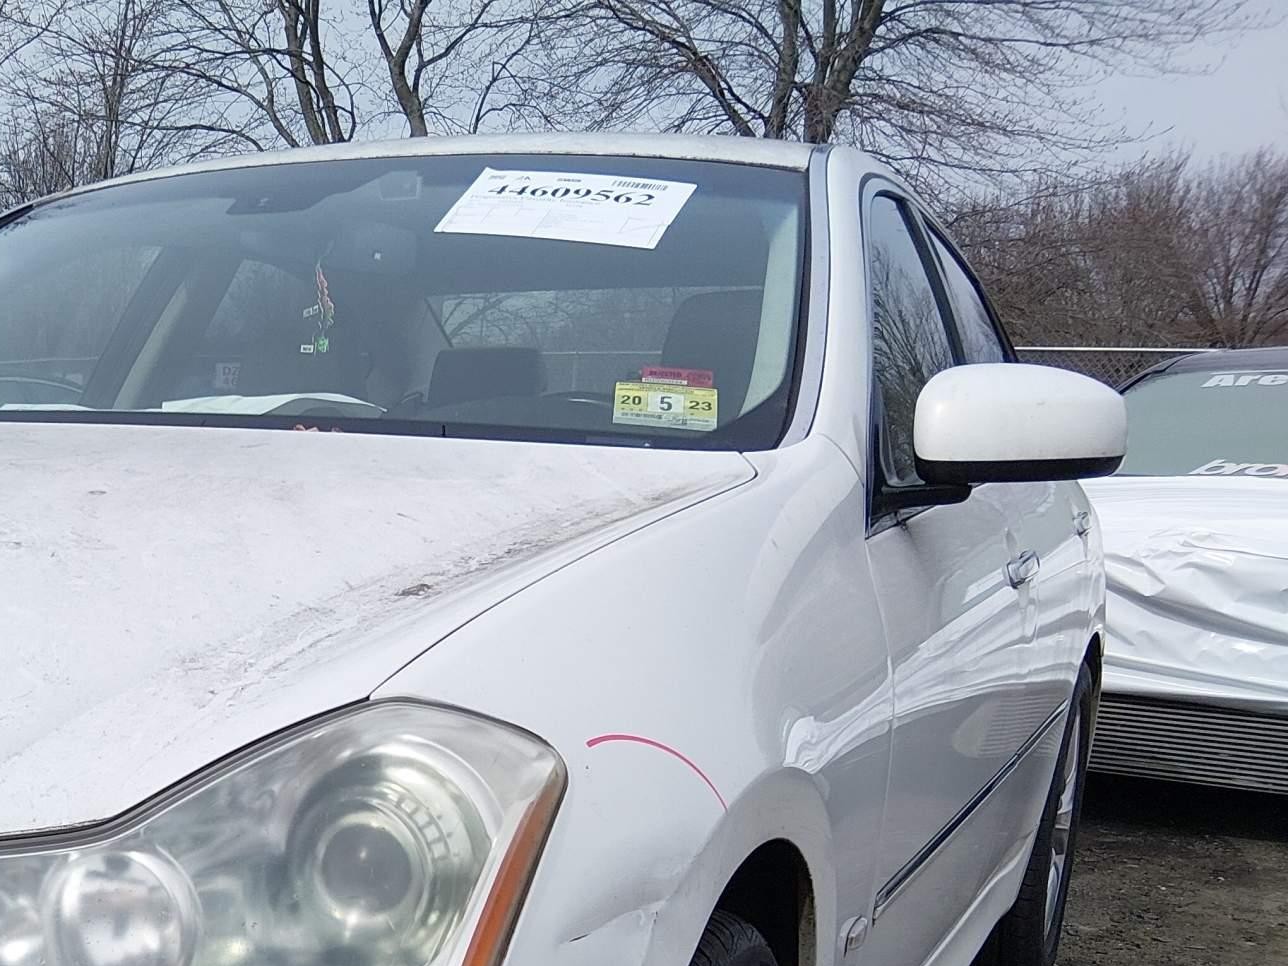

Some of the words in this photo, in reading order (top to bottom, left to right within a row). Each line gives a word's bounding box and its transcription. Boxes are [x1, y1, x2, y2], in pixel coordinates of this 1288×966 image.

[487, 184, 655, 206] 44609562
[620, 394, 642, 406] 20
[659, 396, 673, 411] 5
[688, 400, 713, 411] 23
